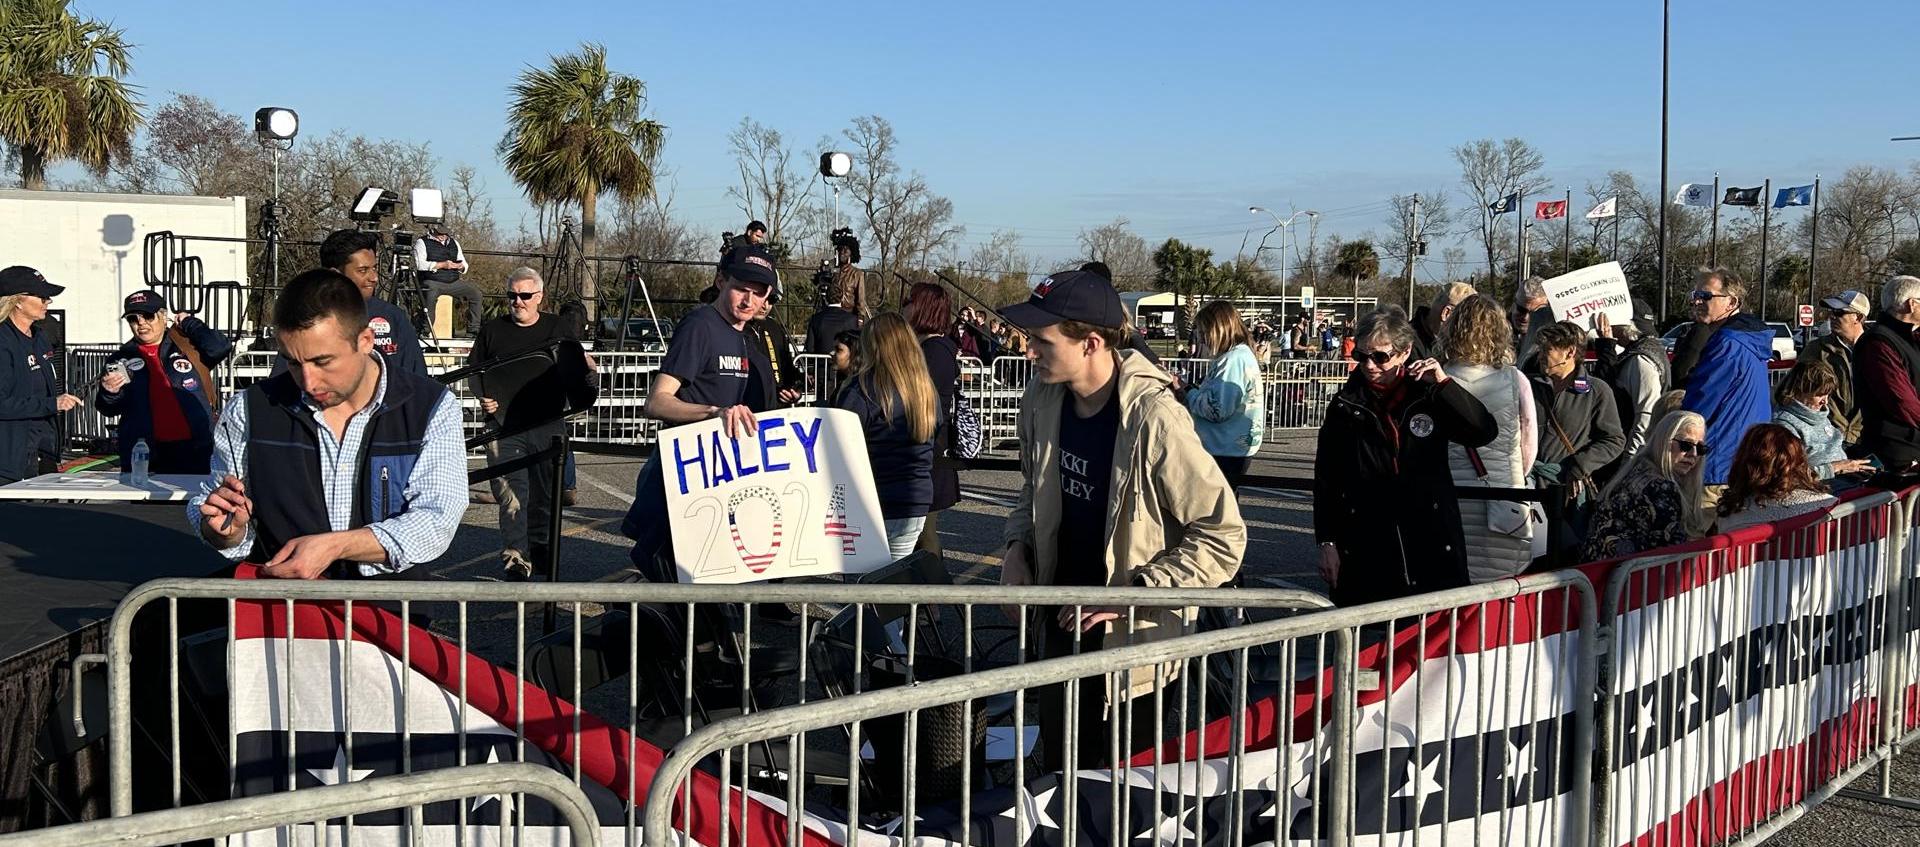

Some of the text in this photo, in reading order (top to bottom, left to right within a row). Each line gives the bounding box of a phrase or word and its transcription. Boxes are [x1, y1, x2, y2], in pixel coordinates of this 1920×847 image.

[1555, 286, 1579, 299] 23456
[673, 417, 822, 495] HALEY
[1060, 448, 1089, 477] KKI
[1061, 474, 1095, 501] LEY
[684, 482, 861, 579] 2024
